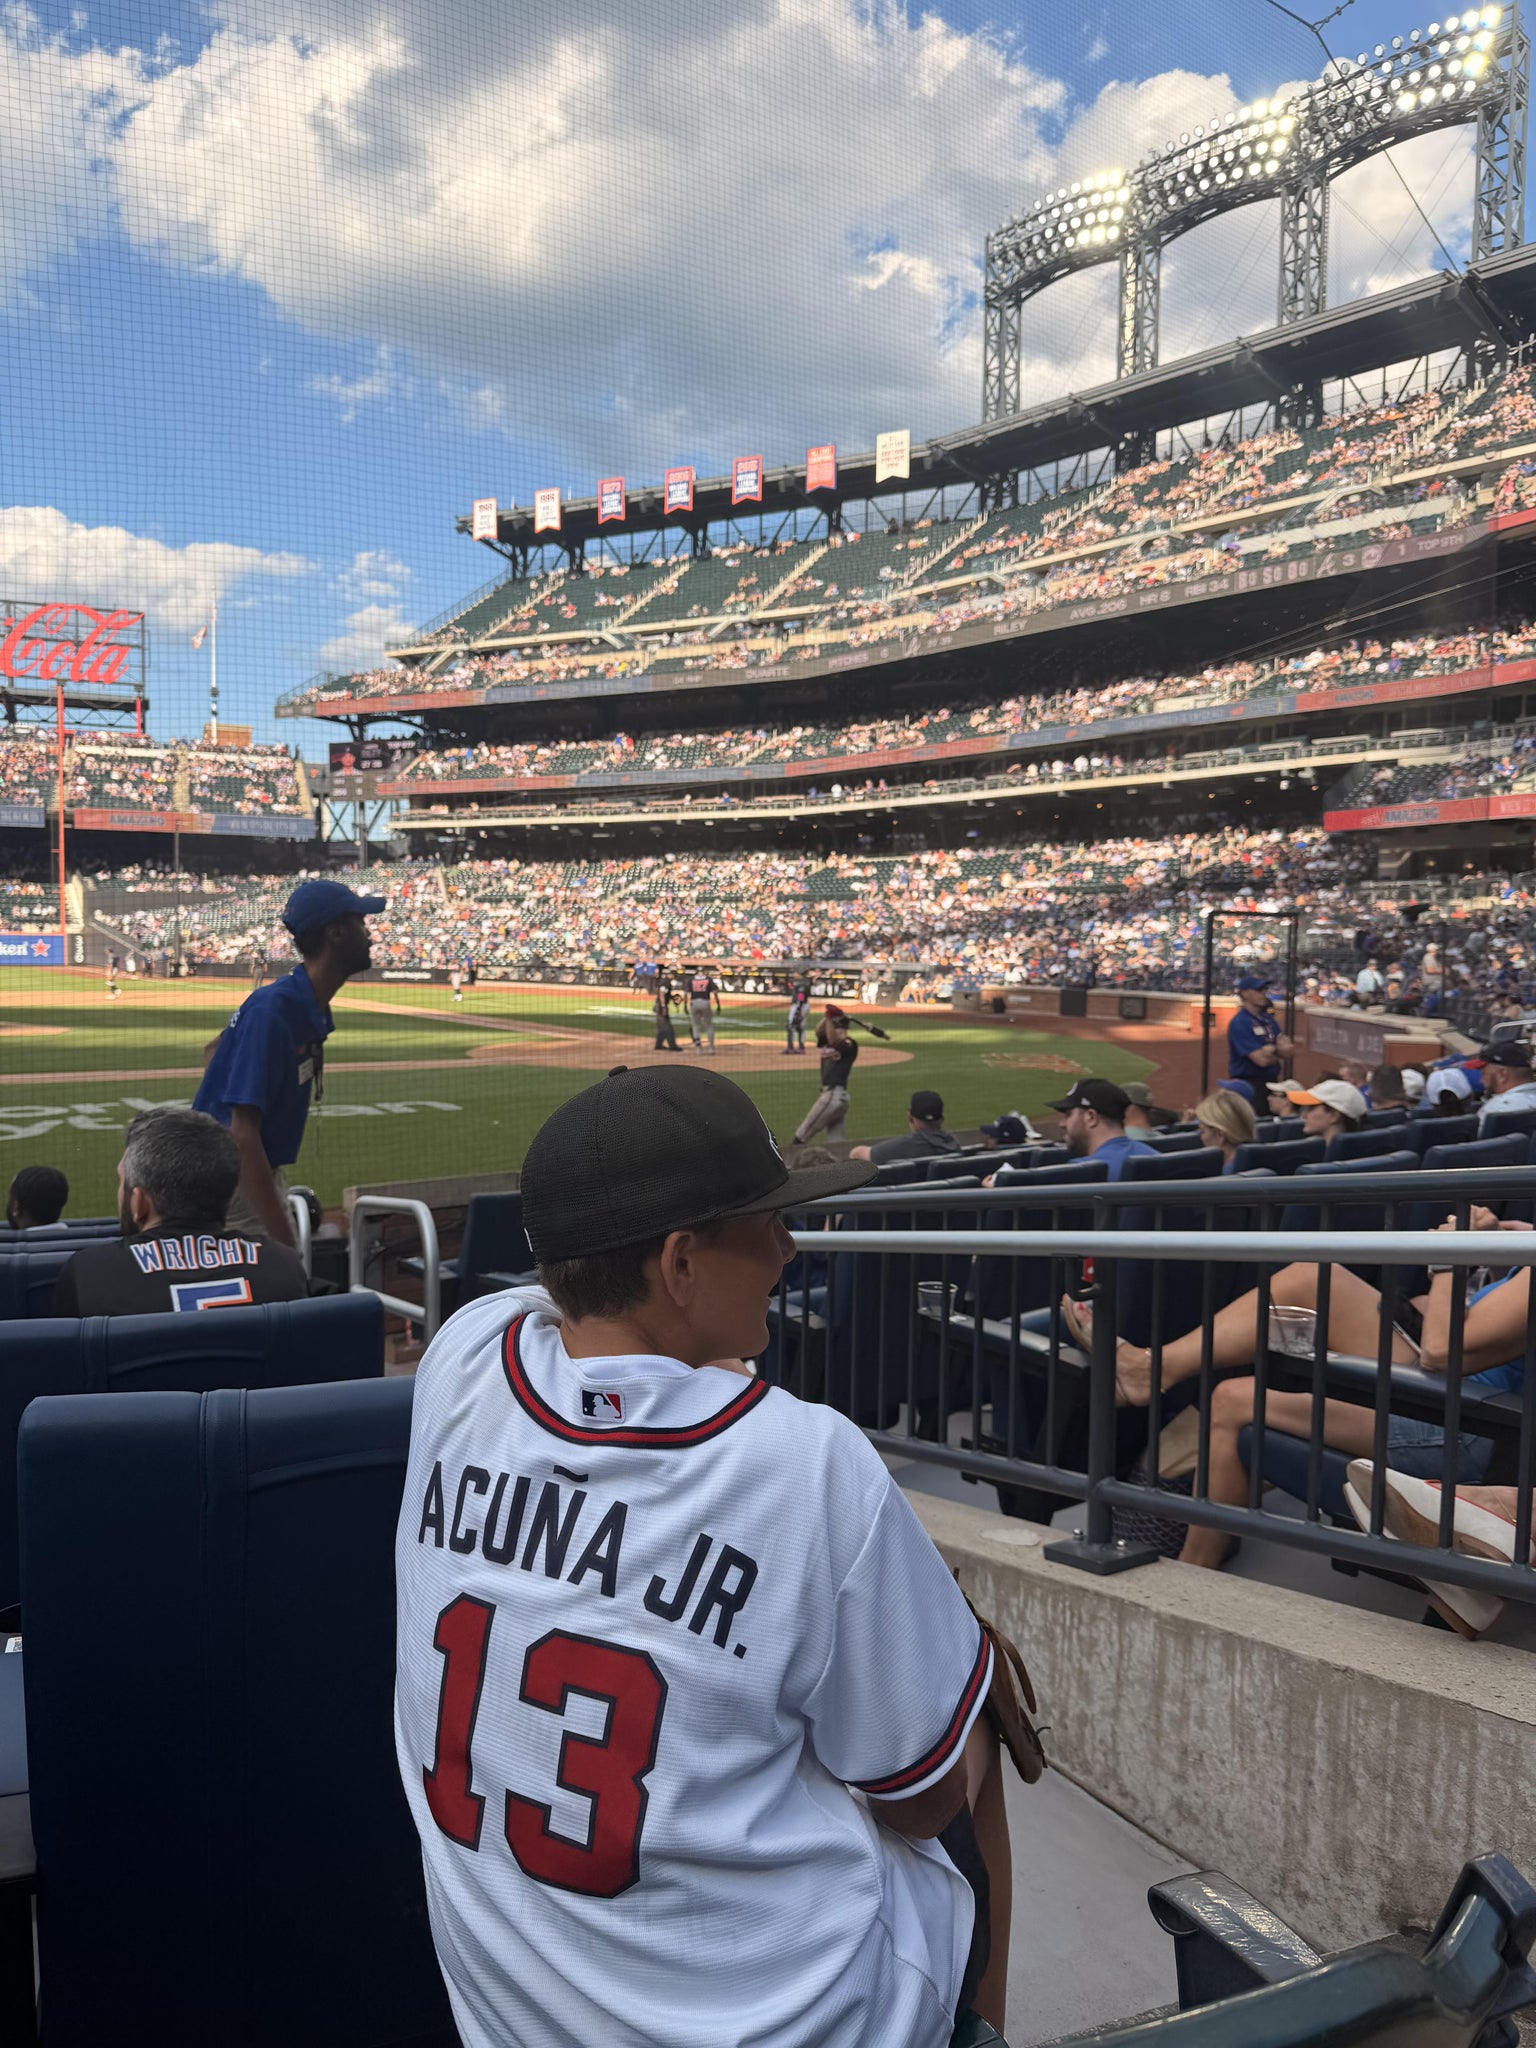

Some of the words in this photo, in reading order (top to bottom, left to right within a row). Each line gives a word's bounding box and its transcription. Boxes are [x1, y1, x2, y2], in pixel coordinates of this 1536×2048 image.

[993, 619, 1029, 636] RILEY
[1069, 606, 1095, 621] AVG
[1139, 592, 1158, 606] HR
[1184, 583, 1207, 598] RBI
[129, 1235, 262, 1273] WRIGHT
[418, 1461, 628, 1598] ACUÑA
[643, 1533, 759, 1658] JR.
[422, 1591, 669, 1898] 13
